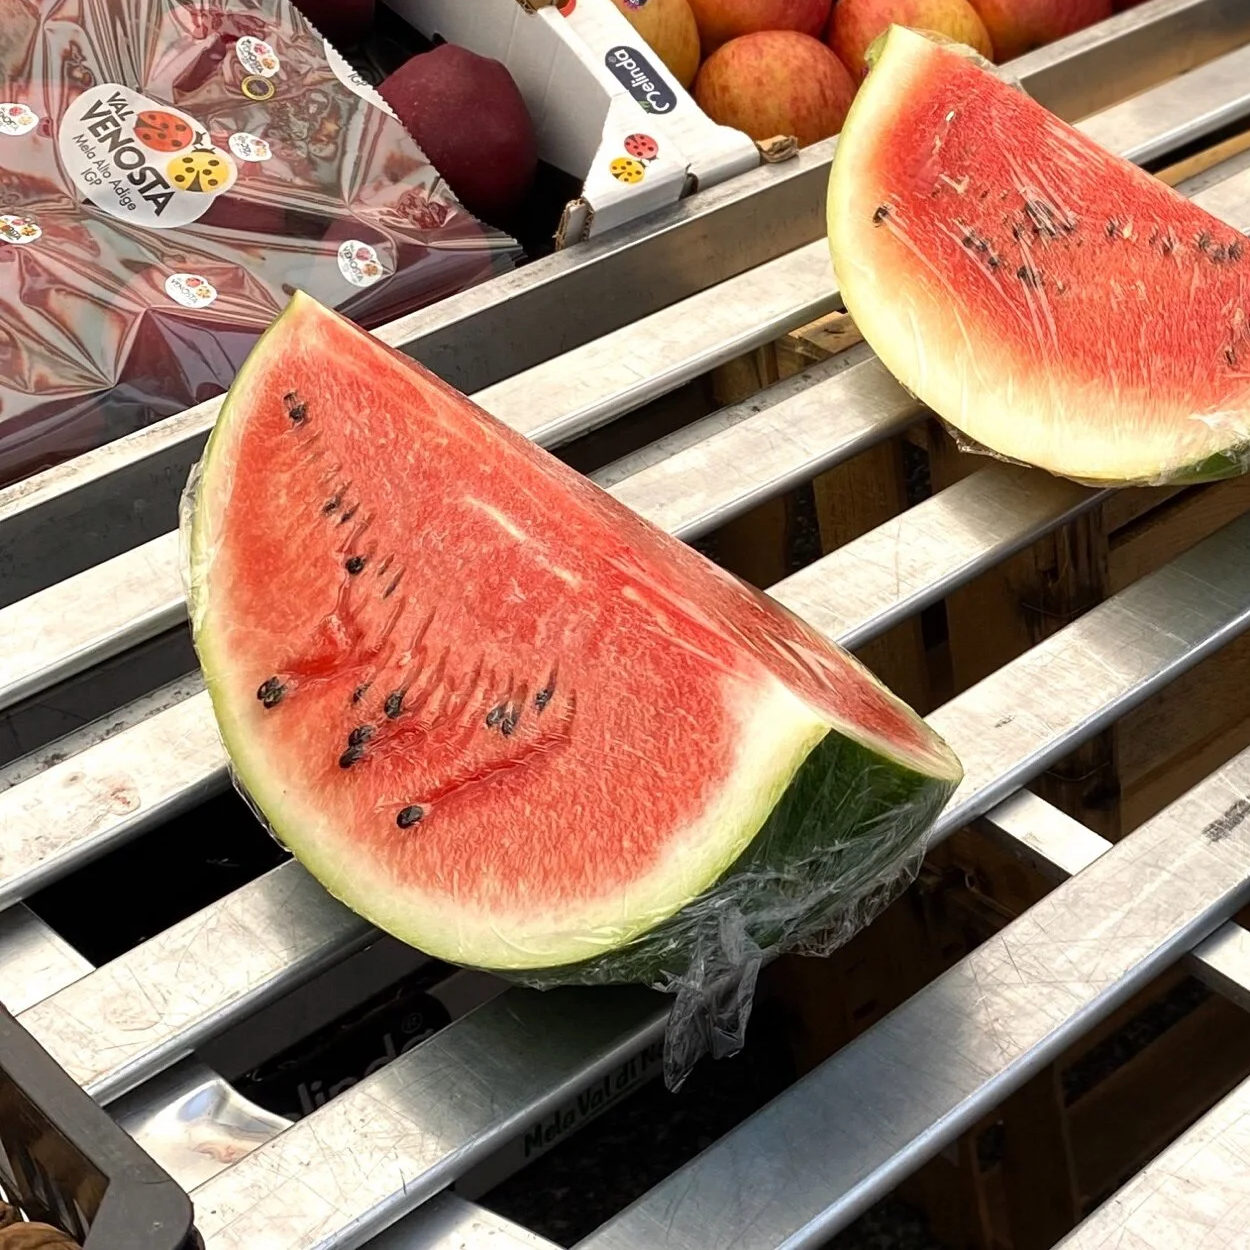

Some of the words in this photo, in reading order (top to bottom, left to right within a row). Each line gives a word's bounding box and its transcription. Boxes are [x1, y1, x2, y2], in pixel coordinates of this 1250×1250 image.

[106, 91, 135, 122] VAL
[613, 48, 670, 112] Melinda
[72, 133, 96, 161] Mela
[94, 158, 112, 180] Alto
[108, 179, 137, 212] Adige
[80, 99, 176, 217] VENOSTA
[80, 167, 103, 187] IGP
